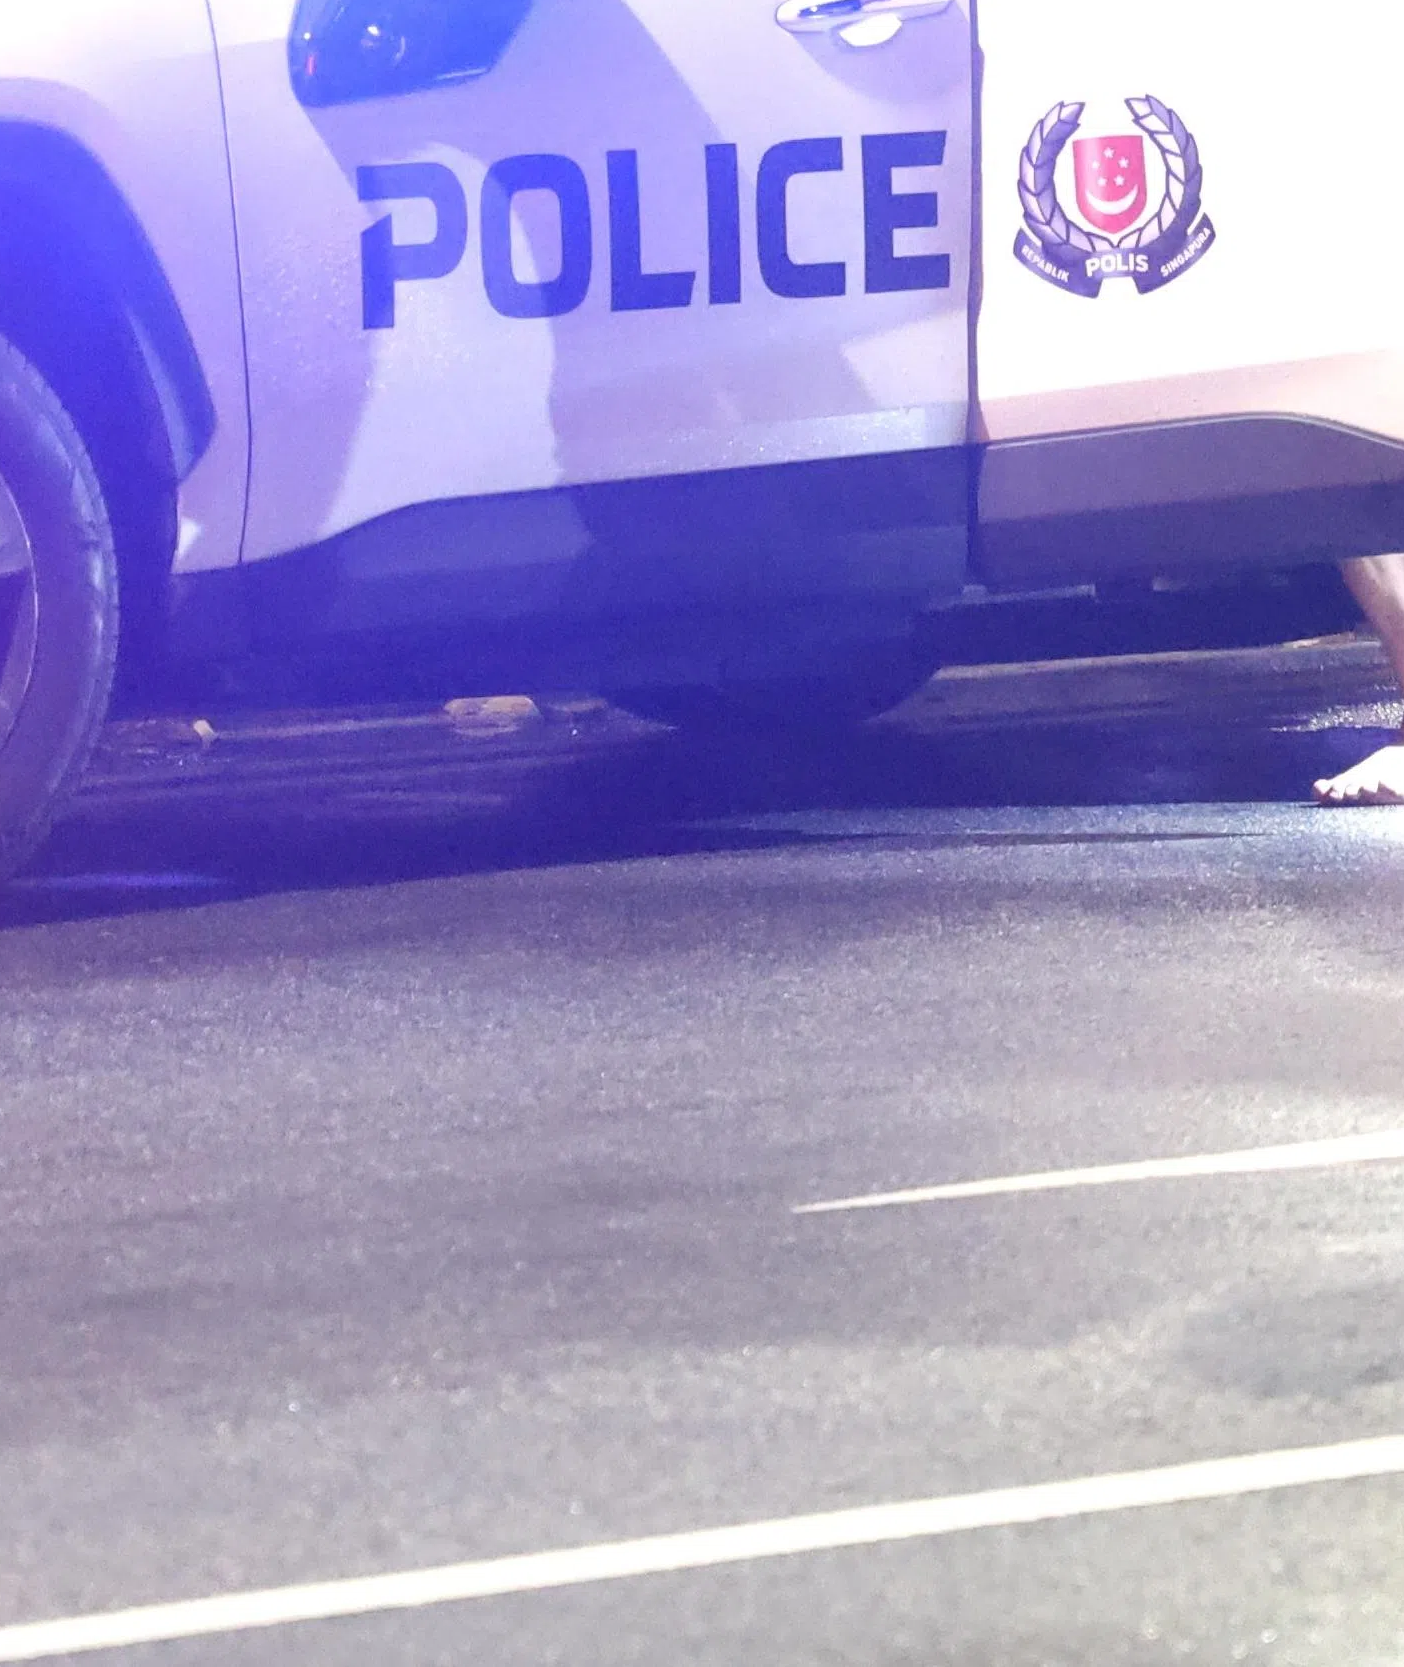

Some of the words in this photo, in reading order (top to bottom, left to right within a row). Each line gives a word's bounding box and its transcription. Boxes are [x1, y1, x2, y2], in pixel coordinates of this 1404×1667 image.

[356, 131, 950, 331] POLICE
[1084, 252, 1150, 277] POLIS
[1160, 227, 1211, 278] SINGAPURA
